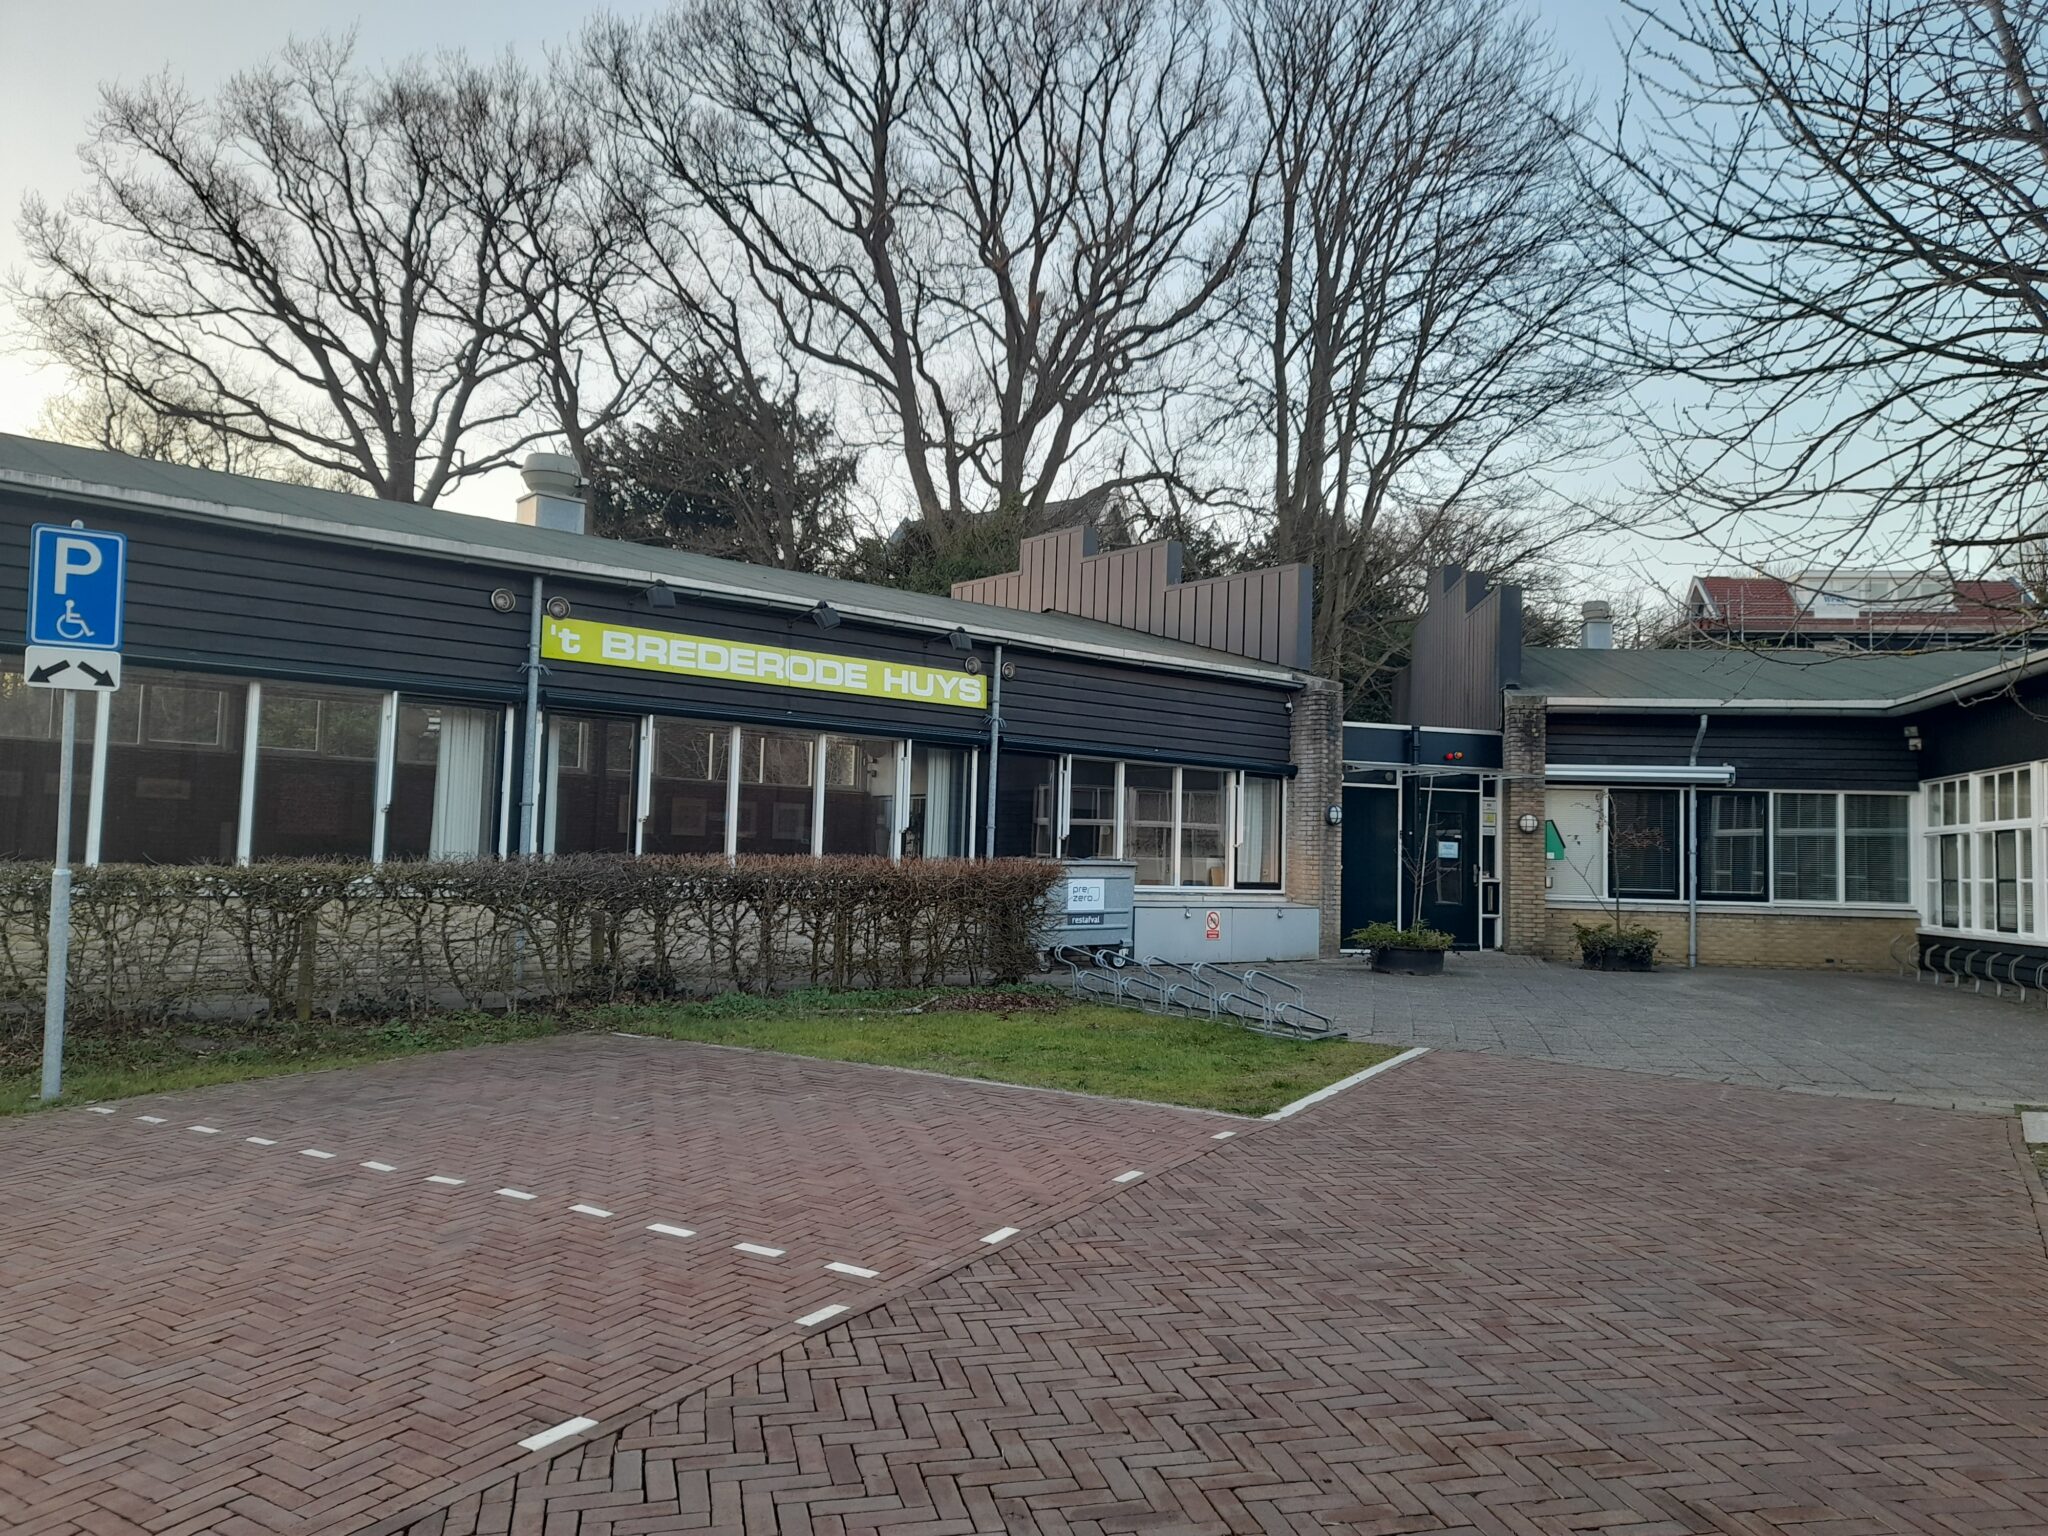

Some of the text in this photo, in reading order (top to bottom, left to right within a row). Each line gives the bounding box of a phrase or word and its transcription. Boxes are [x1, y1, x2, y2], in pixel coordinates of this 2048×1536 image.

[54, 537, 102, 595] P
[550, 624, 982, 703] 't BREDERODE HUYS
[1073, 886, 1087, 894] pre
[1072, 915, 1100, 924] restafval
